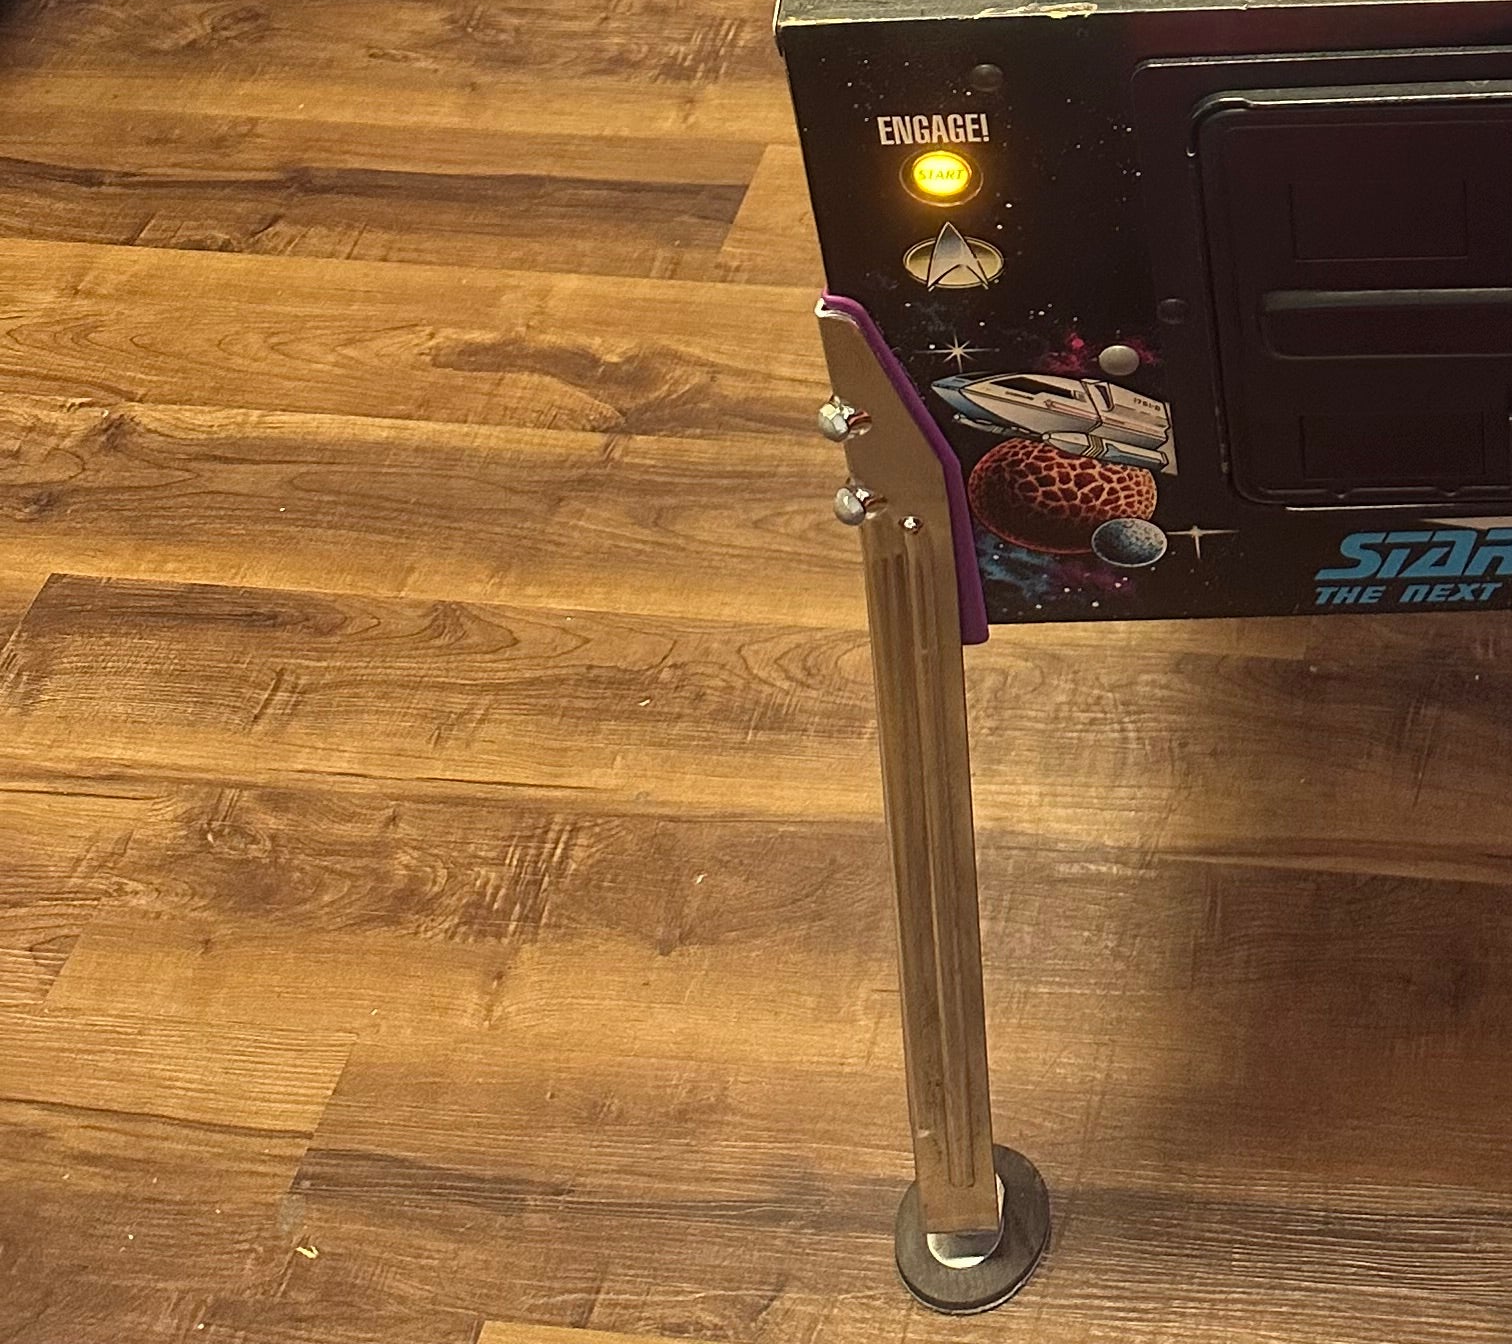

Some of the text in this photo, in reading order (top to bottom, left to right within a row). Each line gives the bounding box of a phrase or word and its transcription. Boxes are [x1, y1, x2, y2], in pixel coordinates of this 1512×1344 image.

[877, 113, 990, 145] ENGAGE!
[918, 169, 965, 181] START
[1315, 585, 1386, 606] THE
[1400, 582, 1503, 603] NEXT
